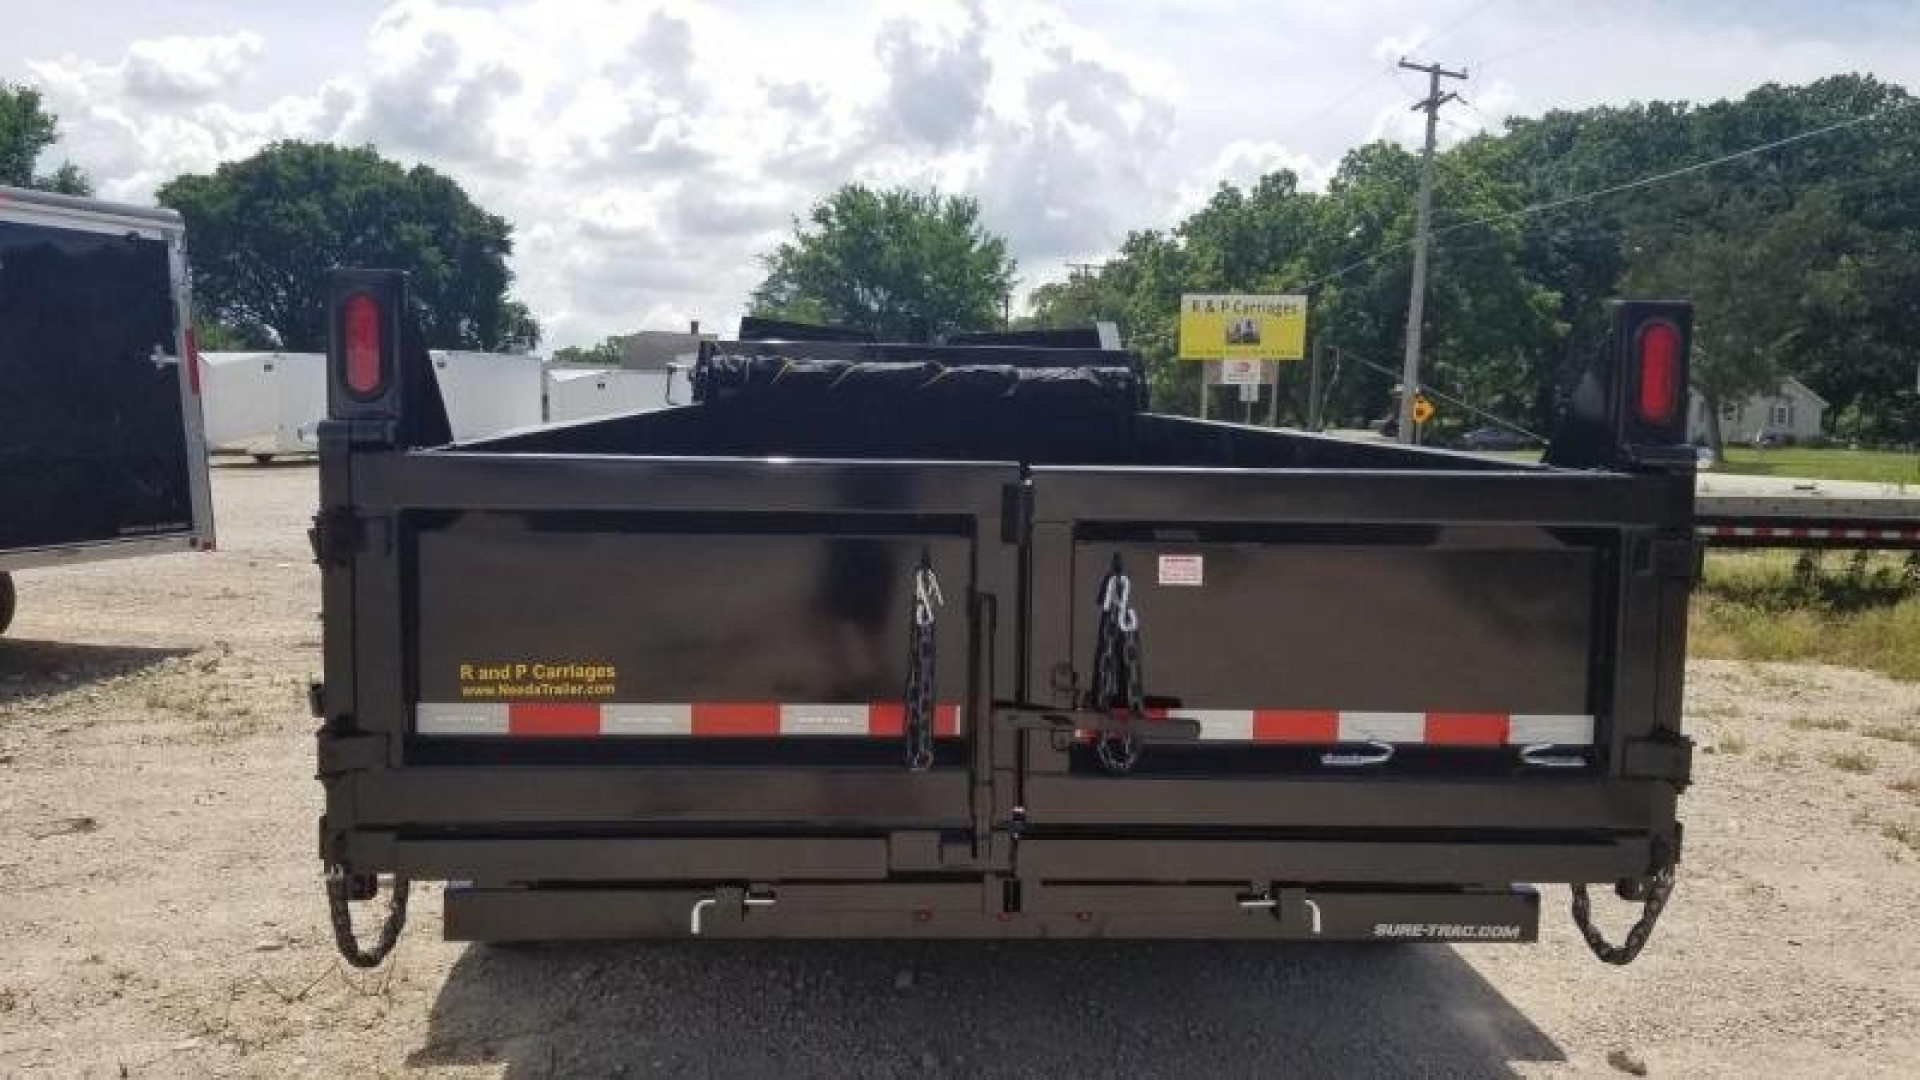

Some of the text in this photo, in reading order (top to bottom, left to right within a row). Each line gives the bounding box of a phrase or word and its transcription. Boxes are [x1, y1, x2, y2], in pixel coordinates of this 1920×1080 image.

[1205, 300, 1215, 313] &
[1221, 300, 1230, 313] P
[1233, 300, 1298, 317] Carriages
[461, 664, 615, 682] R and P Carriages
[1374, 923, 1520, 937] SURE-TRAC.COM
